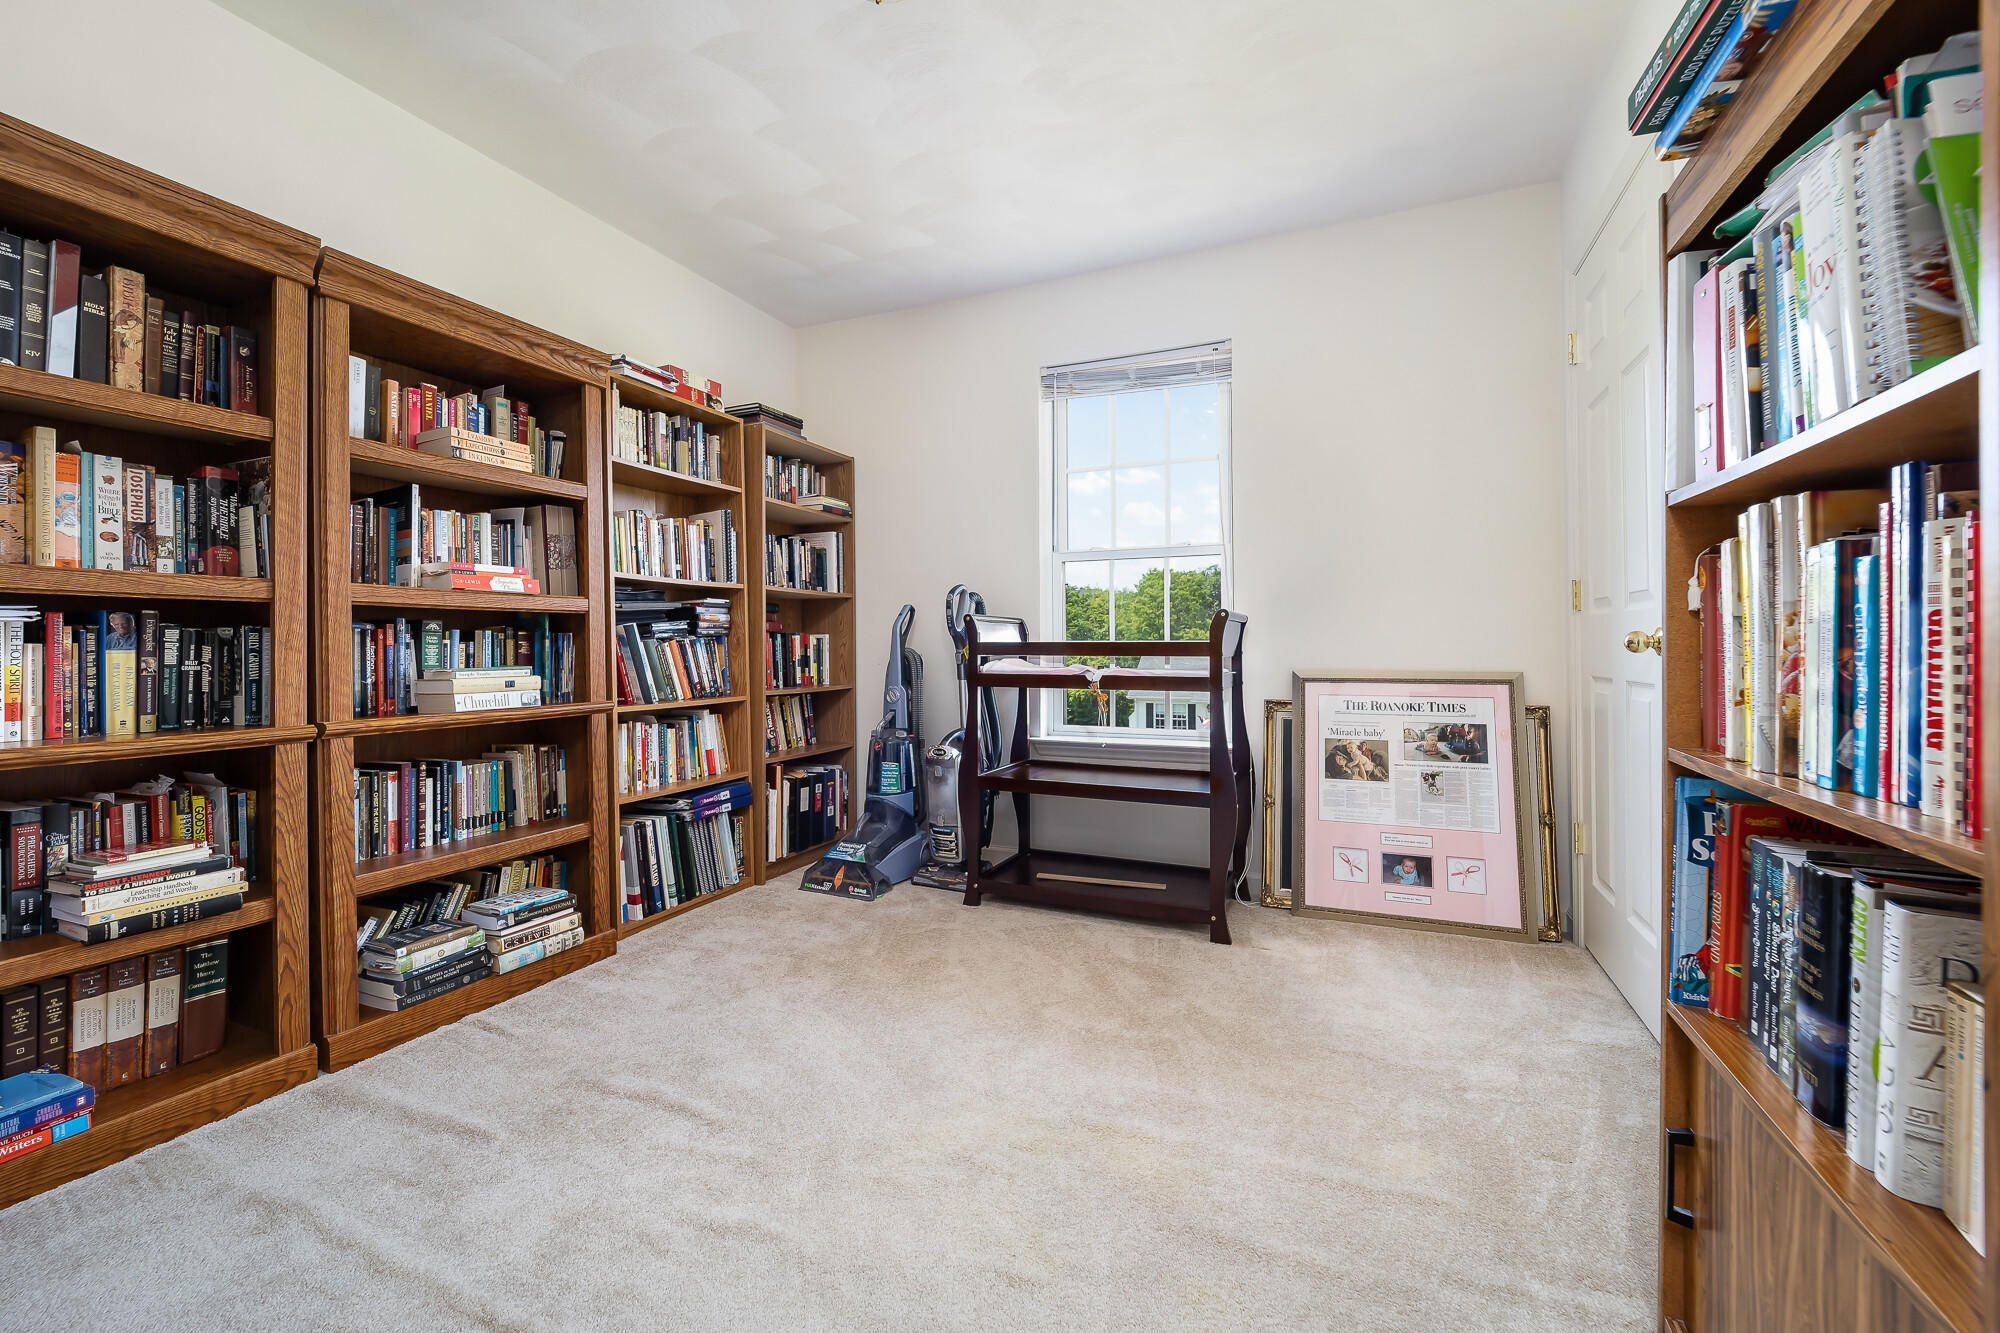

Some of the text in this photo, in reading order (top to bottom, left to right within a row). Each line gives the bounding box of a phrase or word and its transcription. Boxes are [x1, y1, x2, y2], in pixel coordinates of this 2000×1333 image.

[1648, 31, 1721, 126] PEANUTS 1000 PIECE
[1756, 274, 1766, 296] LIKE
[1809, 255, 1839, 302] Joy
[83, 306, 106, 317] BIBLE
[84, 301, 105, 311] HOLY
[1758, 304, 1768, 329] ROCK
[1759, 333, 1770, 359] STAR
[1790, 334, 1802, 388] MICHAELS
[1760, 362, 1771, 389] ANNE
[426, 390, 434, 421] DANIEL
[1762, 391, 1774, 431] BURRELL
[468, 451, 500, 466] INKLINGS
[130, 470, 146, 522] JOSEPHUS
[219, 500, 229, 516] THE
[98, 506, 122, 516] BIBLE
[219, 516, 229, 540] BIBLE
[143, 619, 156, 652] Evangelist
[164, 629, 180, 643] Billy
[9, 626, 23, 696] THE HOLY SPIRIT
[163, 643, 180, 665] Graham
[248, 632, 260, 680] BILLY GRAHAM
[202, 646, 212, 692] Billy Graham
[112, 662, 121, 712] BILLY GRAHAM
[463, 694, 511, 710] Churchill
[1343, 700, 1467, 714] THE ROANOKE TIMES
[1328, 727, 1387, 740] 'Miracle baby'
[194, 806, 206, 836] GOD'S
[18, 836, 26, 881] SOURCEBOOK
[84, 889, 96, 897] TO
[98, 886, 119, 896] SEEK
[130, 876, 163, 888] NEWER
[165, 870, 196, 881] WORLD
[85, 879, 122, 891] ROBERT
[130, 870, 172, 882] KENNEDY
[130, 880, 192, 898] Leadership Handbook
[130, 892, 161, 904] Preaching
[175, 884, 199, 896] Worship
[542, 901, 572, 913] DEVOTIONAL
[522, 928, 551, 943] LEWIS
[1710, 890, 1723, 964] STORY LAND
[1852, 894, 1868, 965] GREEN
[194, 959, 220, 970] Matthew
[424, 970, 444, 982] STUDIES
[455, 958, 474, 970] SERMON
[442, 969, 460, 980] MOUNT
[188, 978, 225, 991] Commentary
[1770, 966, 1781, 994] Door
[402, 982, 455, 1006] Jesus Freaks
[12, 1130, 34, 1143] MUCH
